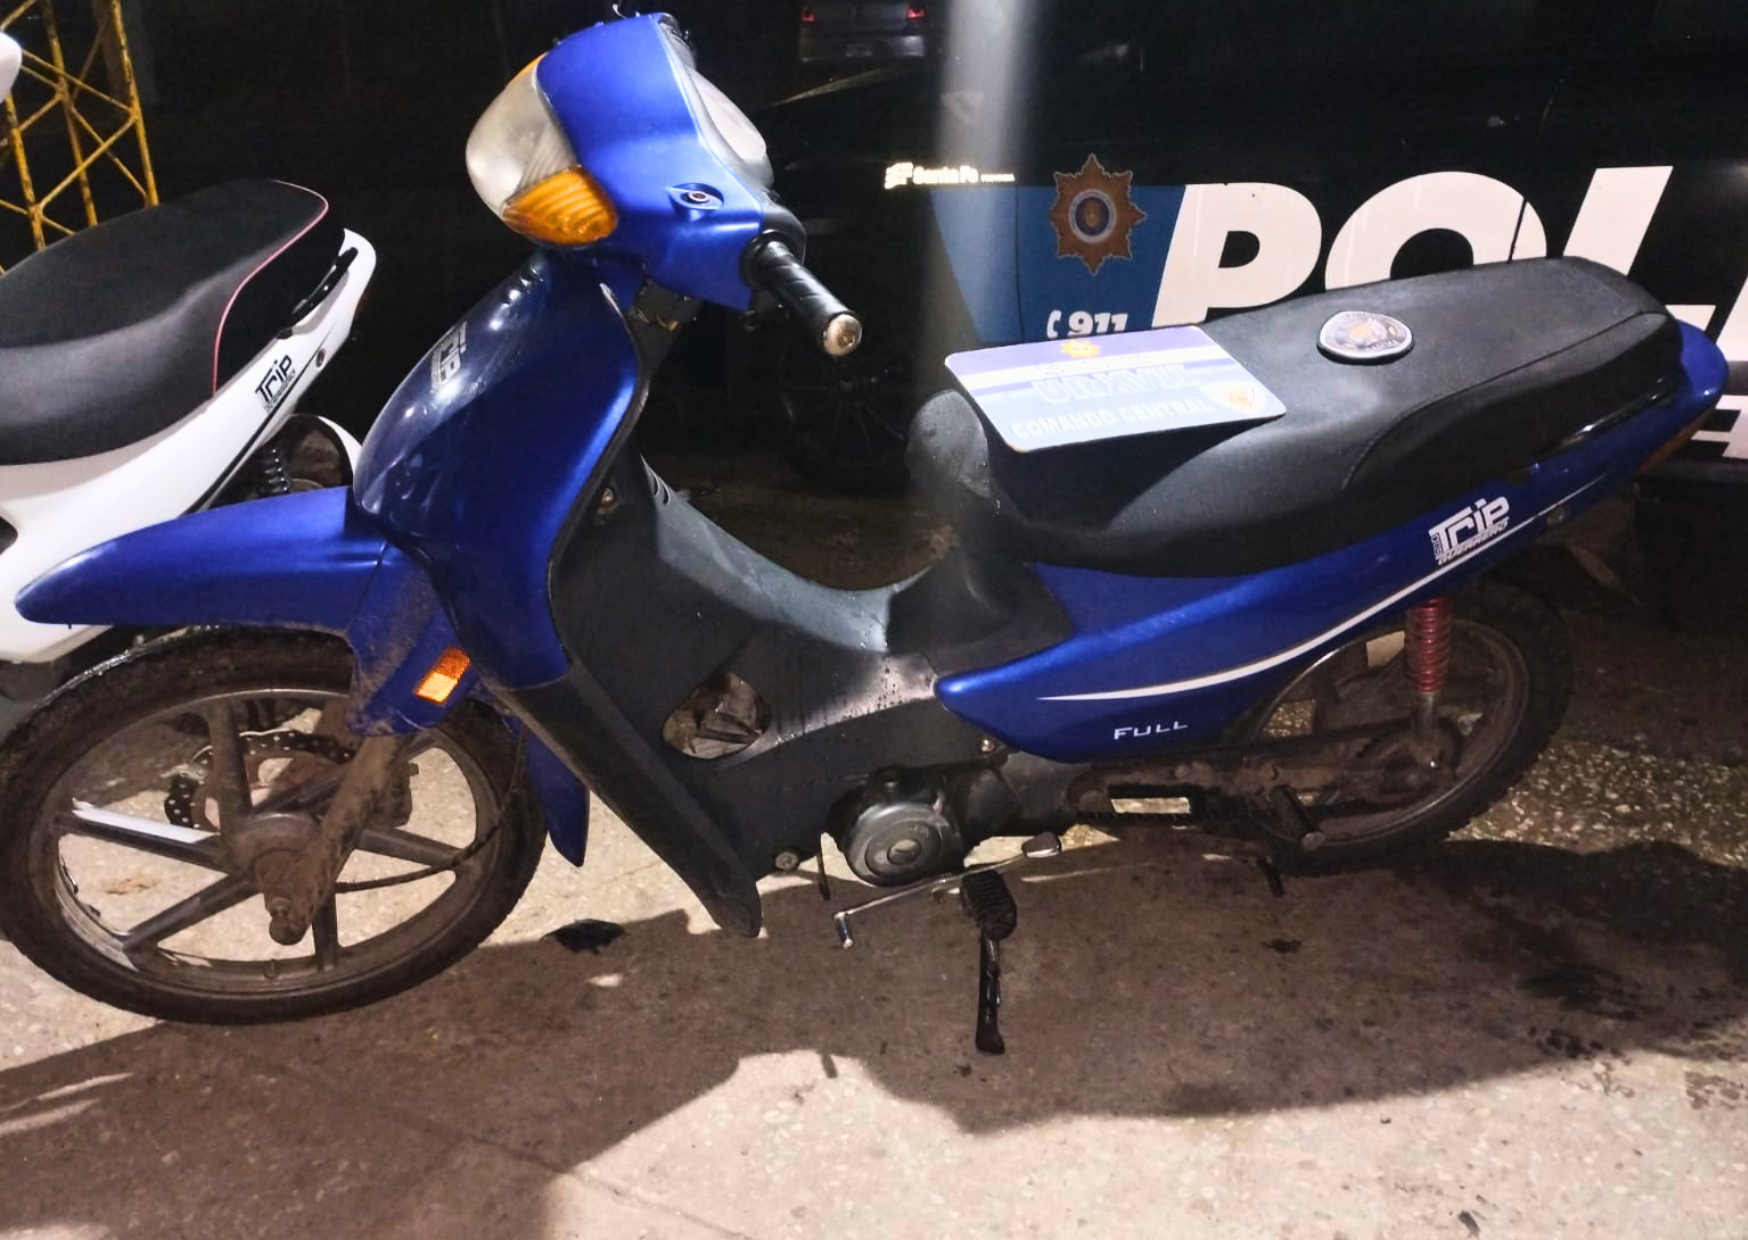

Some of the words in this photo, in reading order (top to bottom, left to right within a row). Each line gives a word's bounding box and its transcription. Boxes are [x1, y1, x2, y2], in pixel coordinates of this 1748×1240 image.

[1068, 310, 1129, 338] 911
[254, 354, 293, 402] Trip
[1010, 406, 1115, 440] COMANDO
[1117, 396, 1218, 424] CENTRAL
[1114, 721, 1188, 740] FULL
